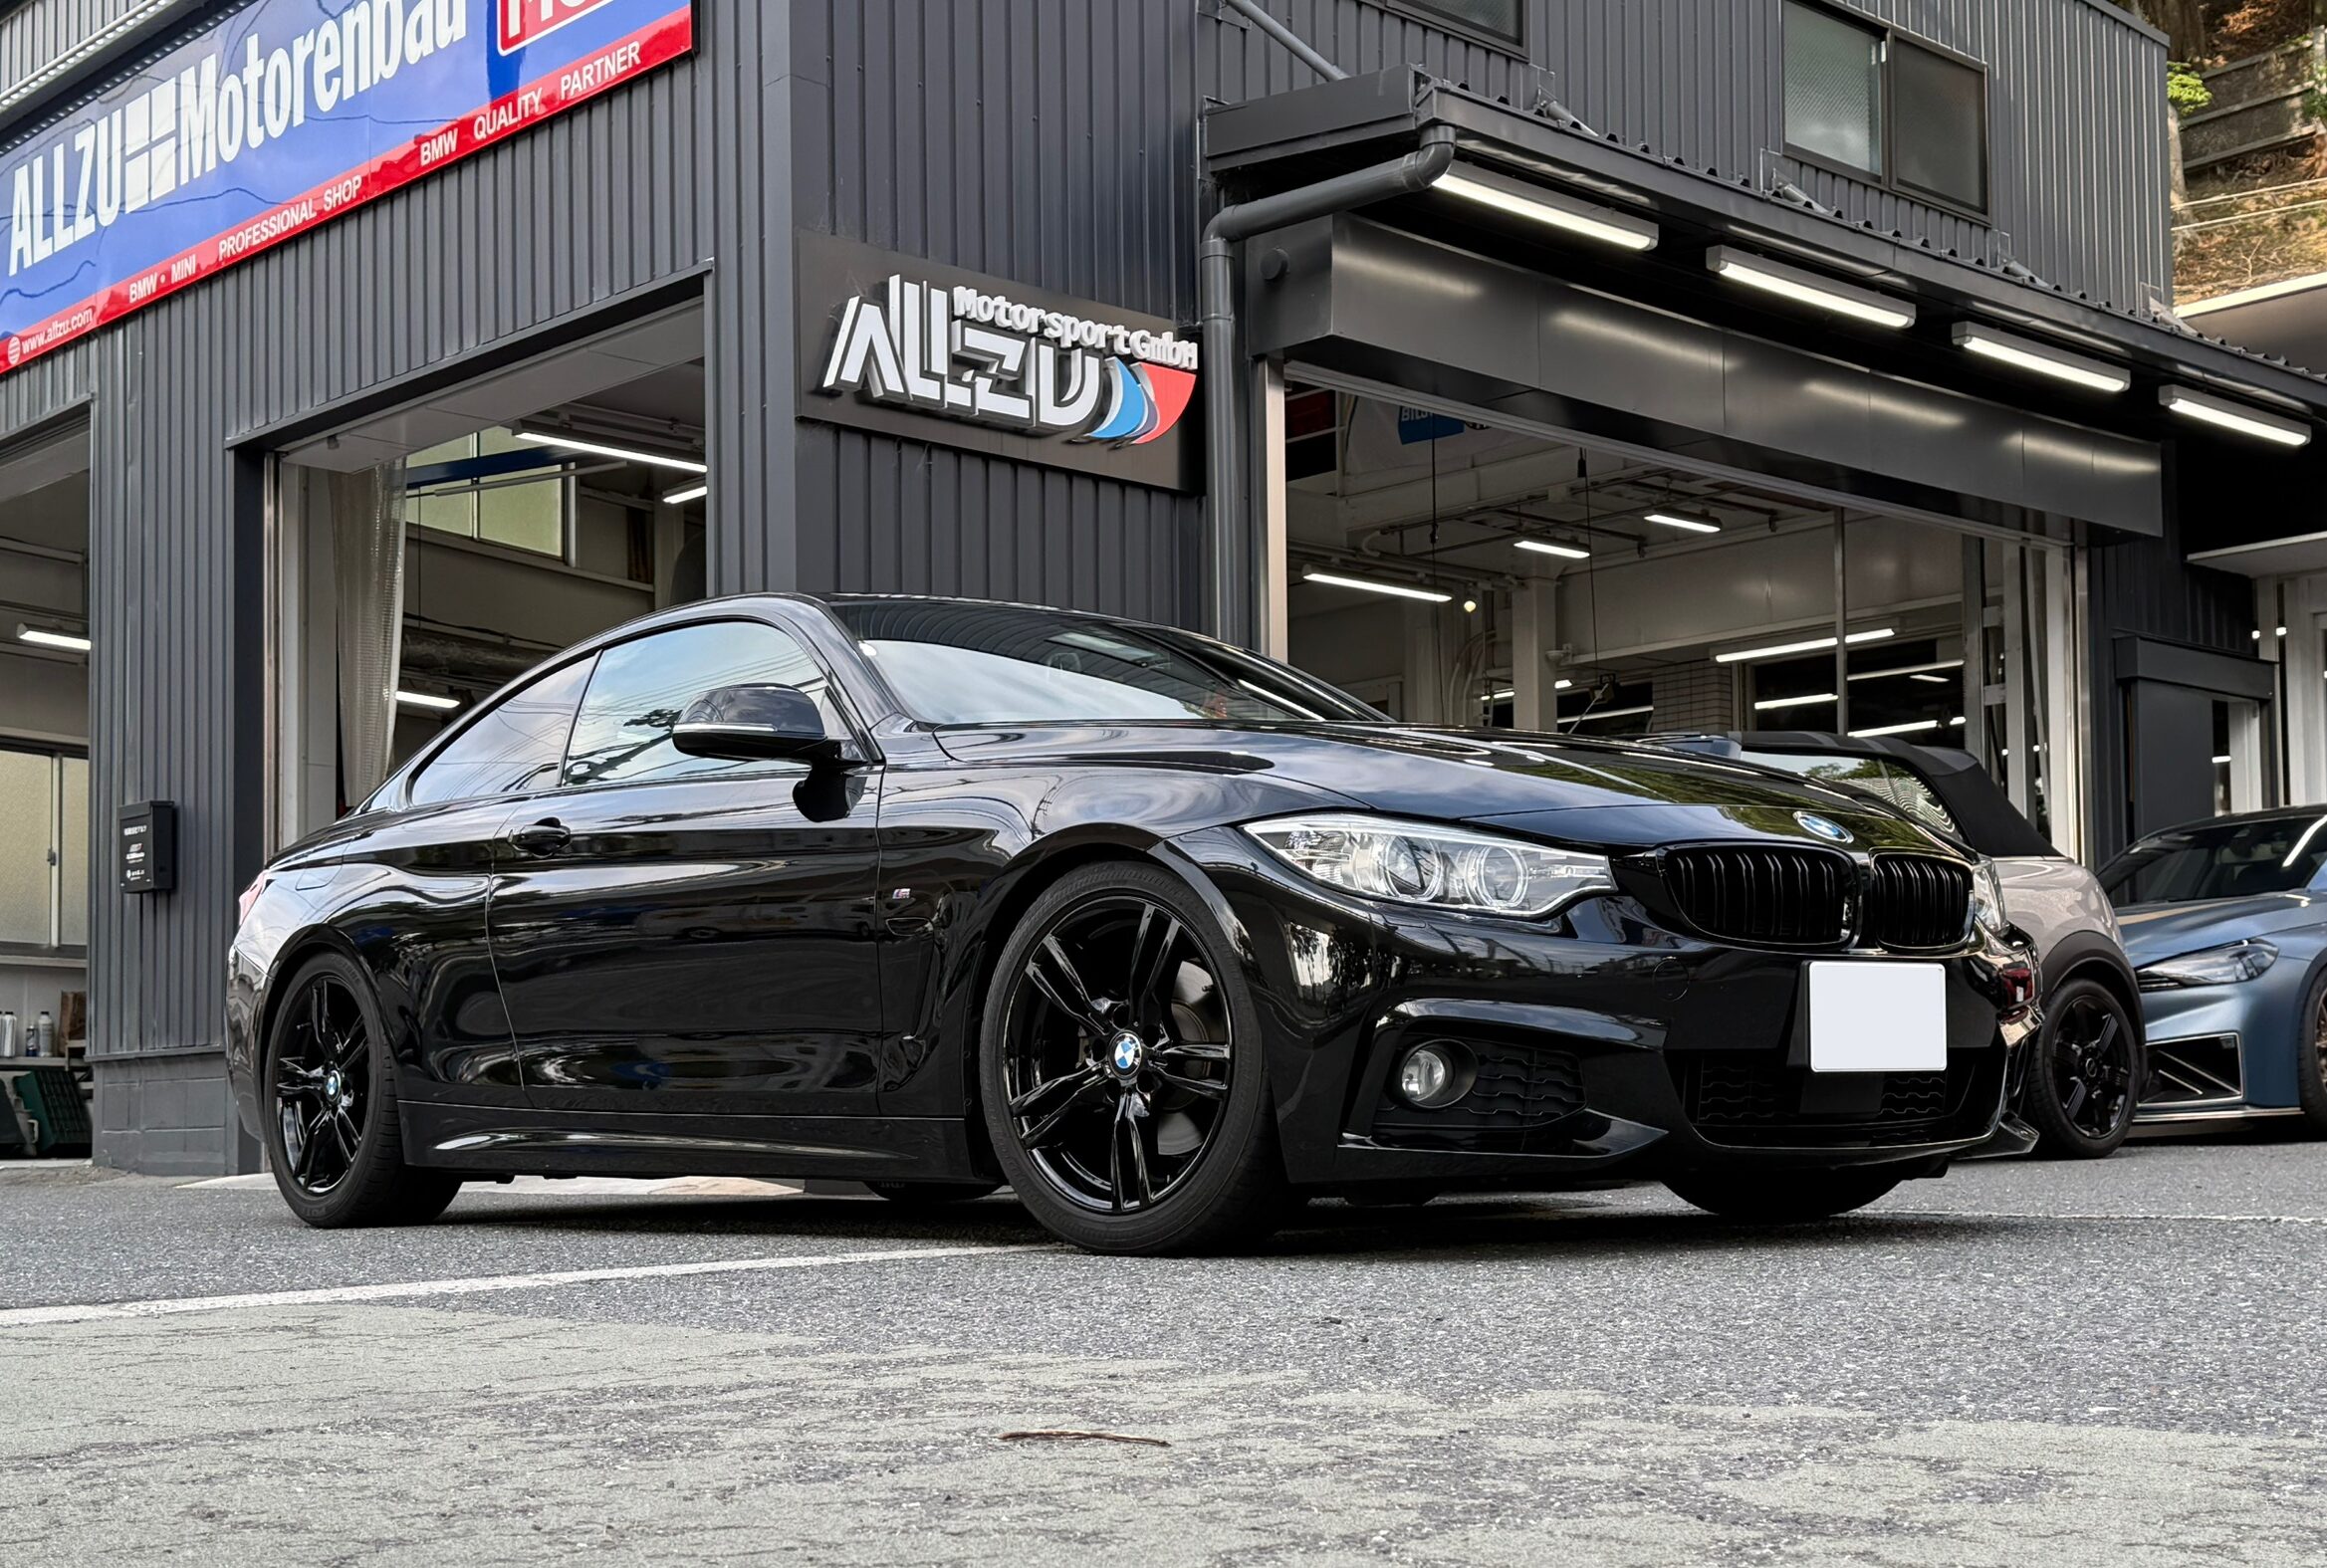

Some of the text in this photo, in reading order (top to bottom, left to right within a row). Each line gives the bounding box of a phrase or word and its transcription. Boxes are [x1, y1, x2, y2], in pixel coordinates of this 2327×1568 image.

[9, 0, 466, 277] ALLZU Motorenbau
[418, 40, 641, 166] BMW QUALITY PARTNER
[128, 174, 362, 303] BMW MINI PROFESSIONAL SHOP
[22, 308, 93, 354] www.allzu.com
[823, 275, 1099, 428] ALLZU
[953, 286, 1198, 370] Motorsport GmbH
